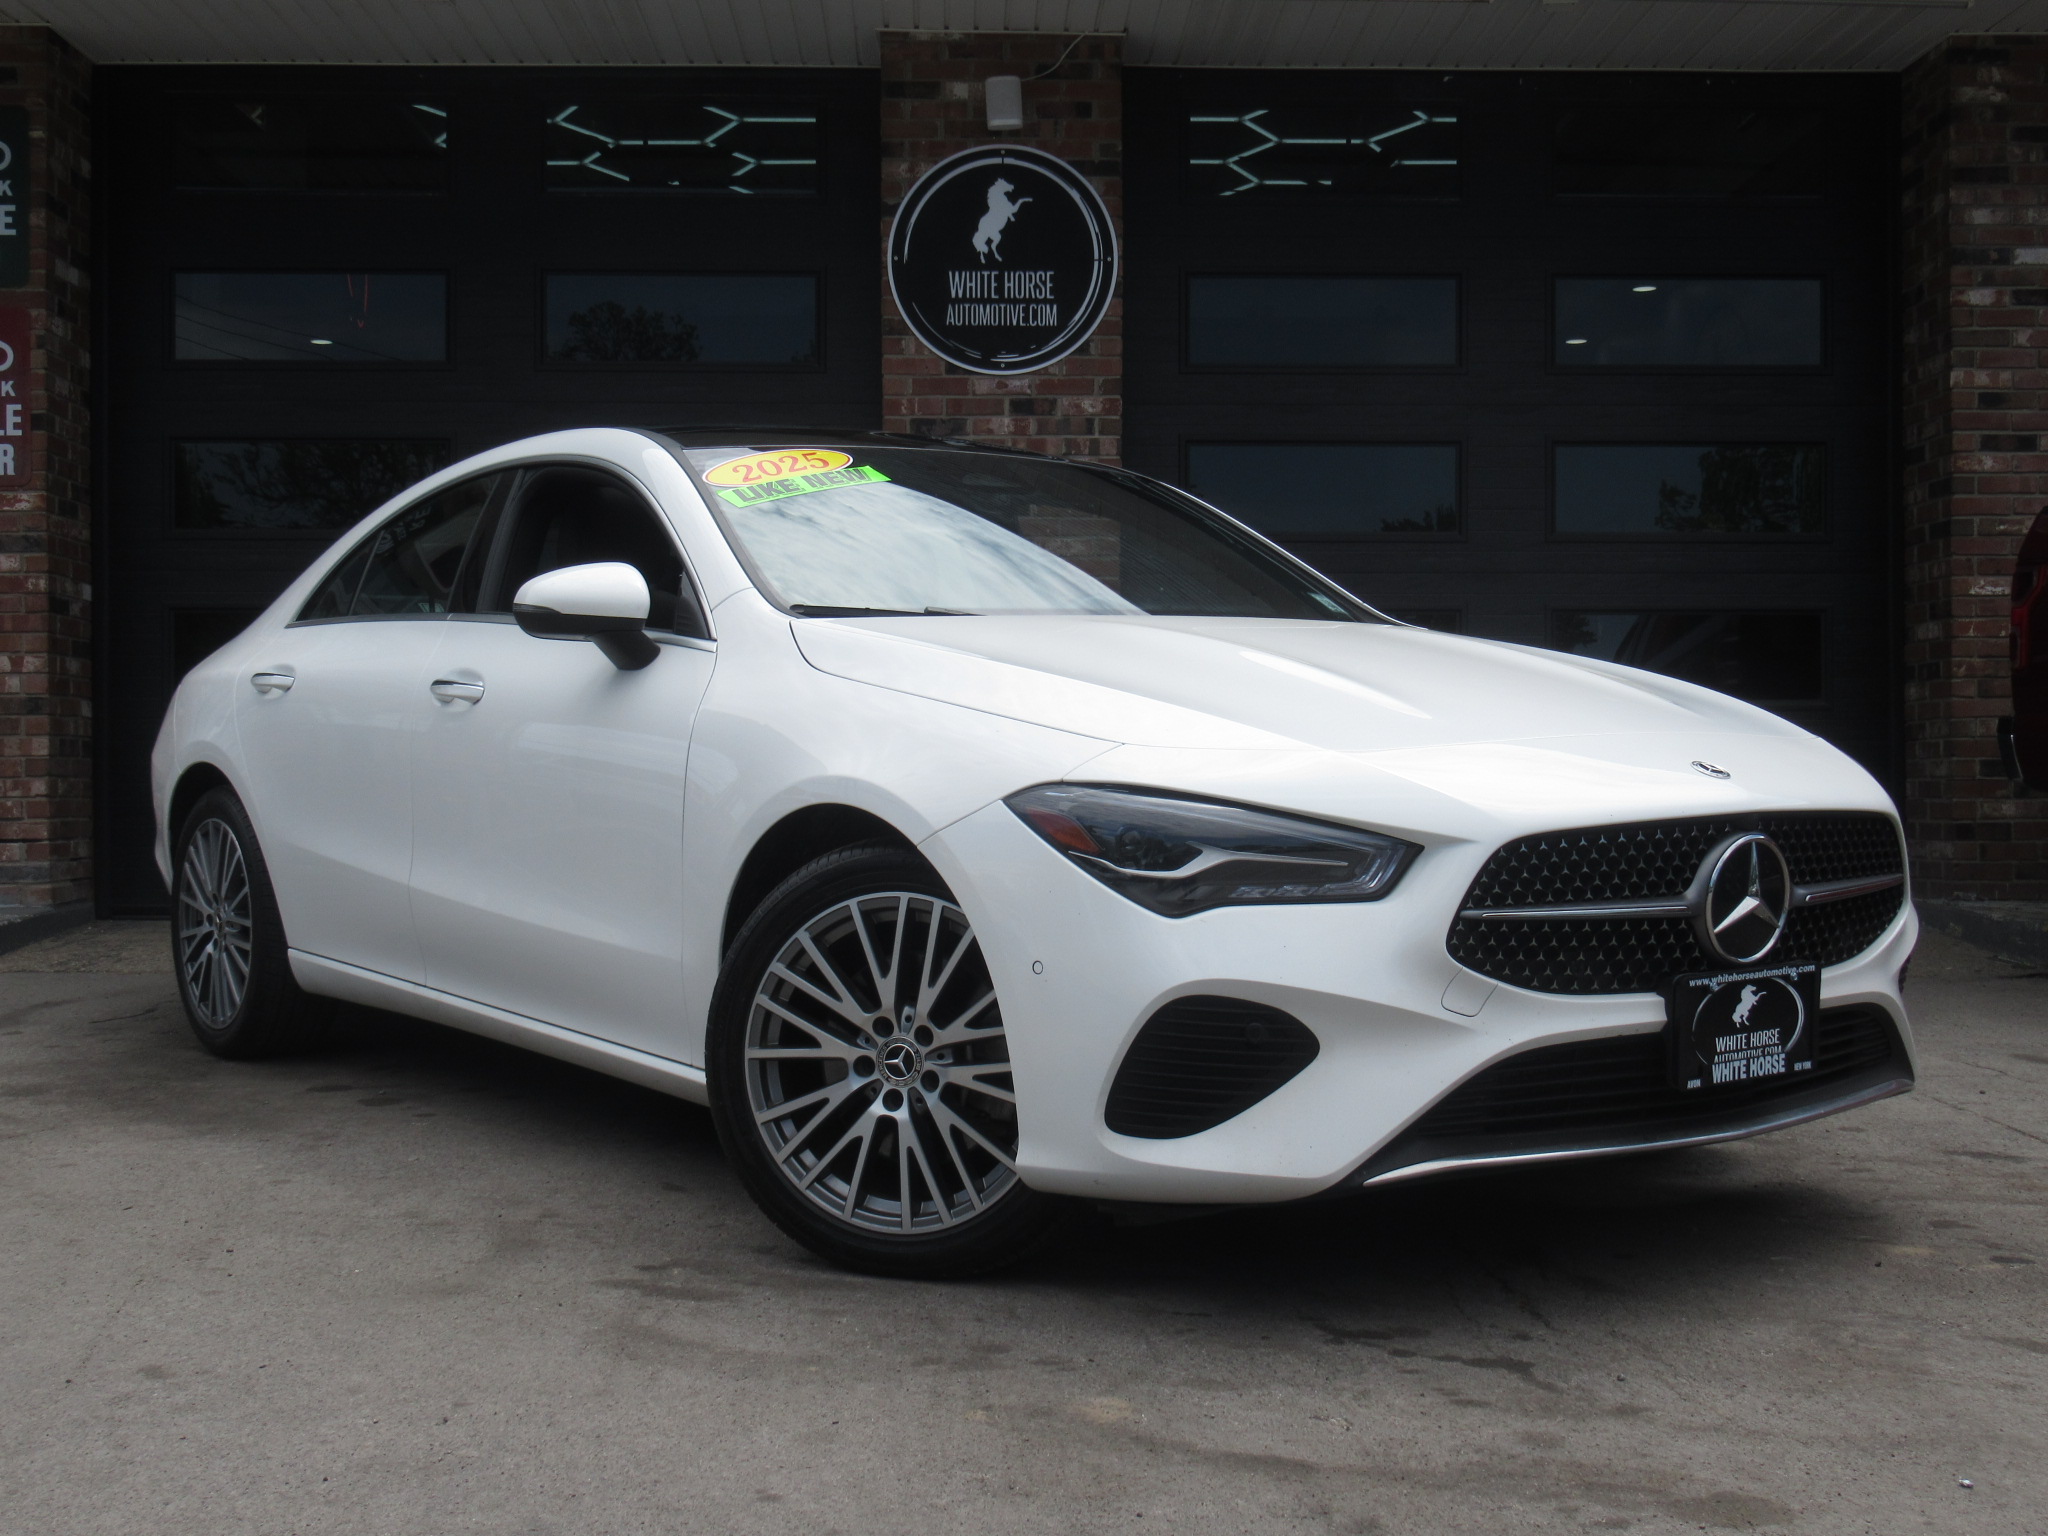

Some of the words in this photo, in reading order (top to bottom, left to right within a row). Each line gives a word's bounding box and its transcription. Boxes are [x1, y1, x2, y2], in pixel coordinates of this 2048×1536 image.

[948, 270, 1000, 300] WHITE
[1004, 270, 1055, 300] HORSE
[946, 303, 1058, 327] AUTOMOTIVE.COM
[732, 452, 830, 483] 2025
[731, 478, 802, 503] LIKE
[800, 468, 873, 489] NEW
[1688, 964, 1816, 987] www.whitehorseautomotive.com
[1715, 1033, 1748, 1053] WHITE
[1750, 1028, 1781, 1048] HORSE
[1712, 1059, 1748, 1084] WHITE
[1750, 1053, 1786, 1078] HORSE
